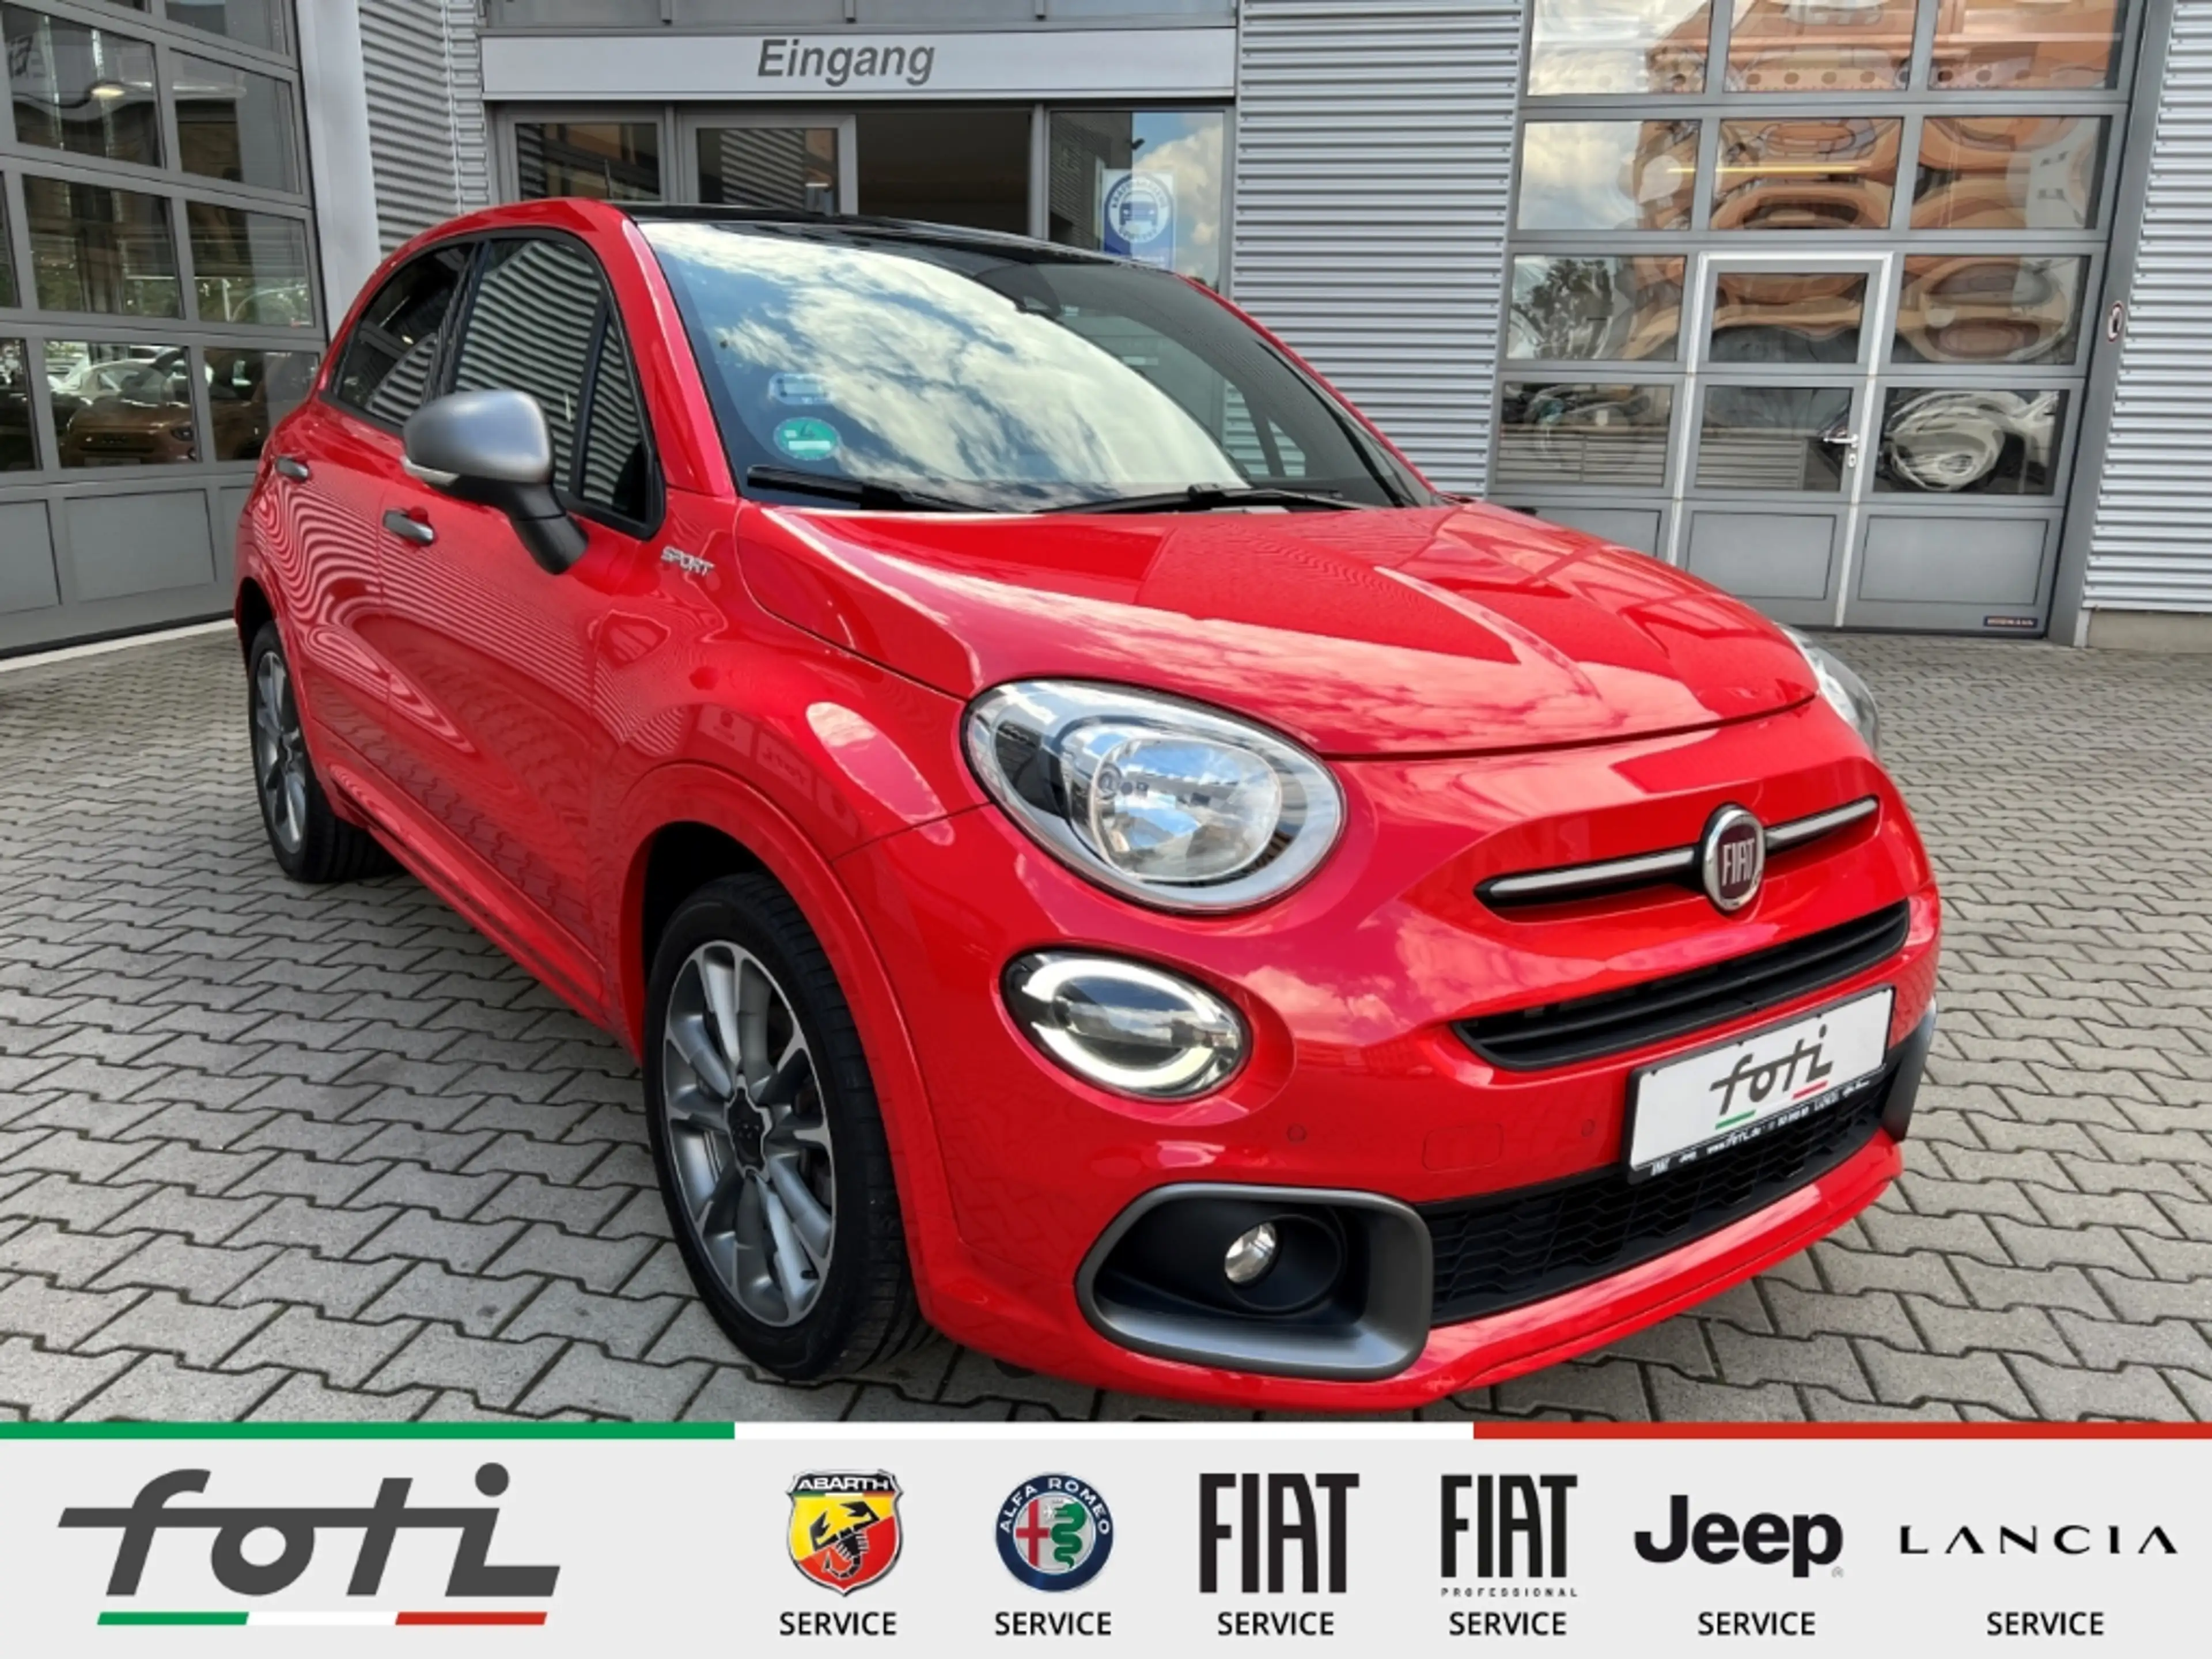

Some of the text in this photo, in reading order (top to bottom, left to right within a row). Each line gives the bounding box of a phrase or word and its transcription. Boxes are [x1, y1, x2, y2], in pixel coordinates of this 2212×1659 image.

[757, 38, 935, 87] Eingang
[661, 545, 715, 577] SPORT
[1722, 838, 1755, 887] FIAT
